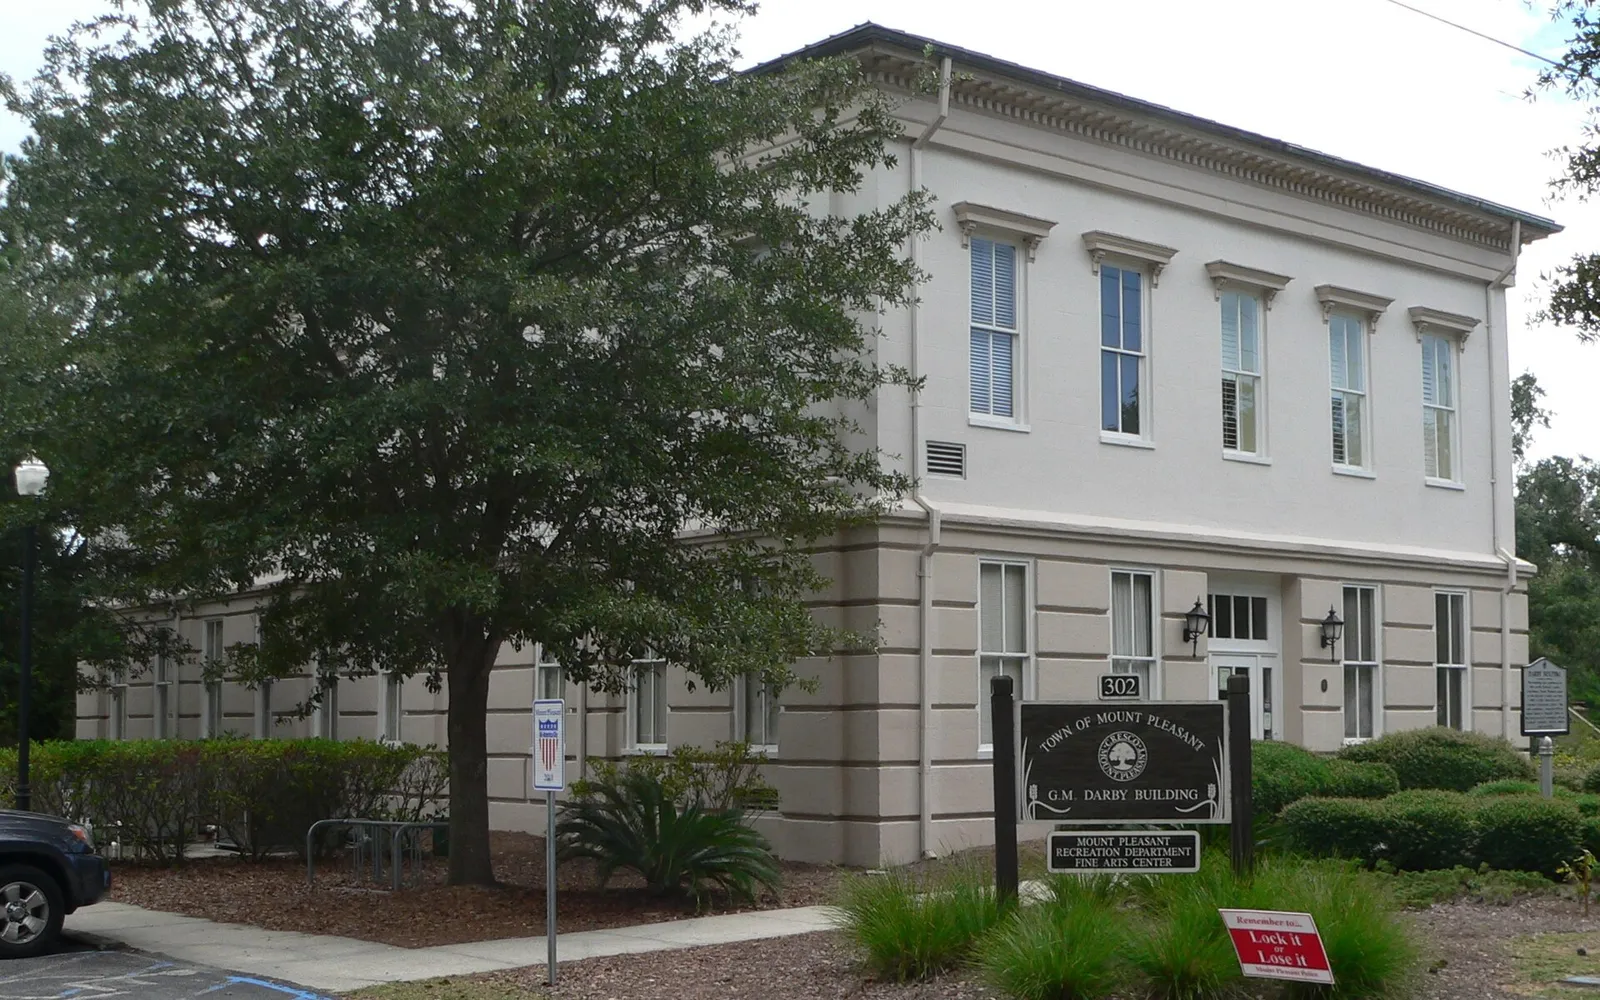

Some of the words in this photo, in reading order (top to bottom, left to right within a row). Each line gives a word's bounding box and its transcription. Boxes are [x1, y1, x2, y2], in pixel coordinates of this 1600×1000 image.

[1104, 678, 1136, 695] 302
[1040, 725, 1073, 753] TOWN
[1076, 717, 1092, 730] OF
[1097, 711, 1143, 725] MOUNT
[1147, 715, 1206, 752] PLEASANT
[1105, 733, 1140, 747] CRESCO
[1100, 749, 1118, 778] MOUNT
[1120, 748, 1146, 780] PLEASANT
[1084, 790, 1129, 800] DARBY
[1135, 789, 1198, 800] BUILDING
[1077, 837, 1114, 846] MOUNT
[1119, 837, 1171, 846] PLEASANT
[1056, 848, 1120, 857] RECREATION
[1125, 847, 1191, 856] DEPARTMENT
[1075, 858, 1098, 867] FINE
[1104, 858, 1128, 867] ARTS
[1133, 858, 1172, 867] CENTER
[1237, 916, 1284, 926] Remember
[1249, 931, 1288, 945] Lock
[1289, 933, 1302, 946] it
[1258, 950, 1292, 965] Lose
[1295, 953, 1308, 966] it
